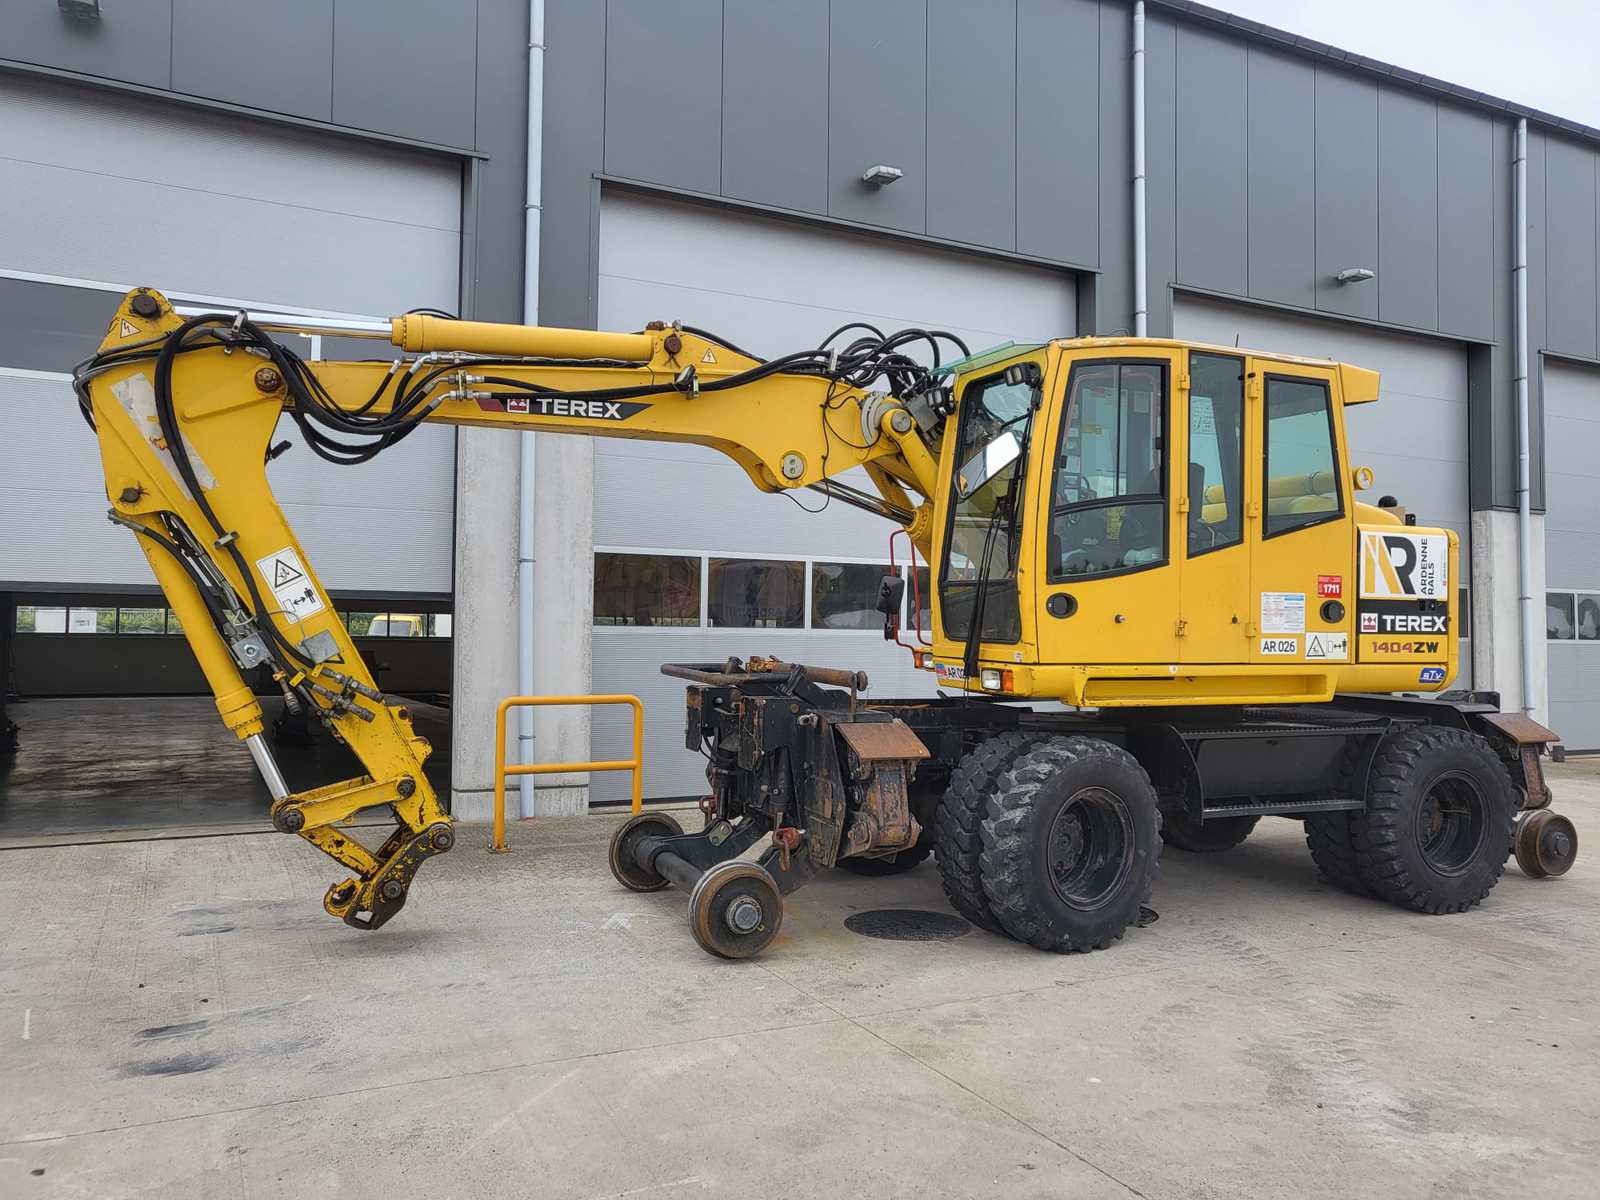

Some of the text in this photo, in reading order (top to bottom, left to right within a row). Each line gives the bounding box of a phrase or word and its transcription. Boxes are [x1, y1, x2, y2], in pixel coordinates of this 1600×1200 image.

[536, 398, 622, 419] TEREX
[1420, 538, 1428, 595] ARDENNE
[1427, 562, 1435, 595] RAILS
[1382, 614, 1447, 632] TEREX
[1262, 640, 1296, 653] AR 026
[1371, 641, 1440, 654] 1404ZW
